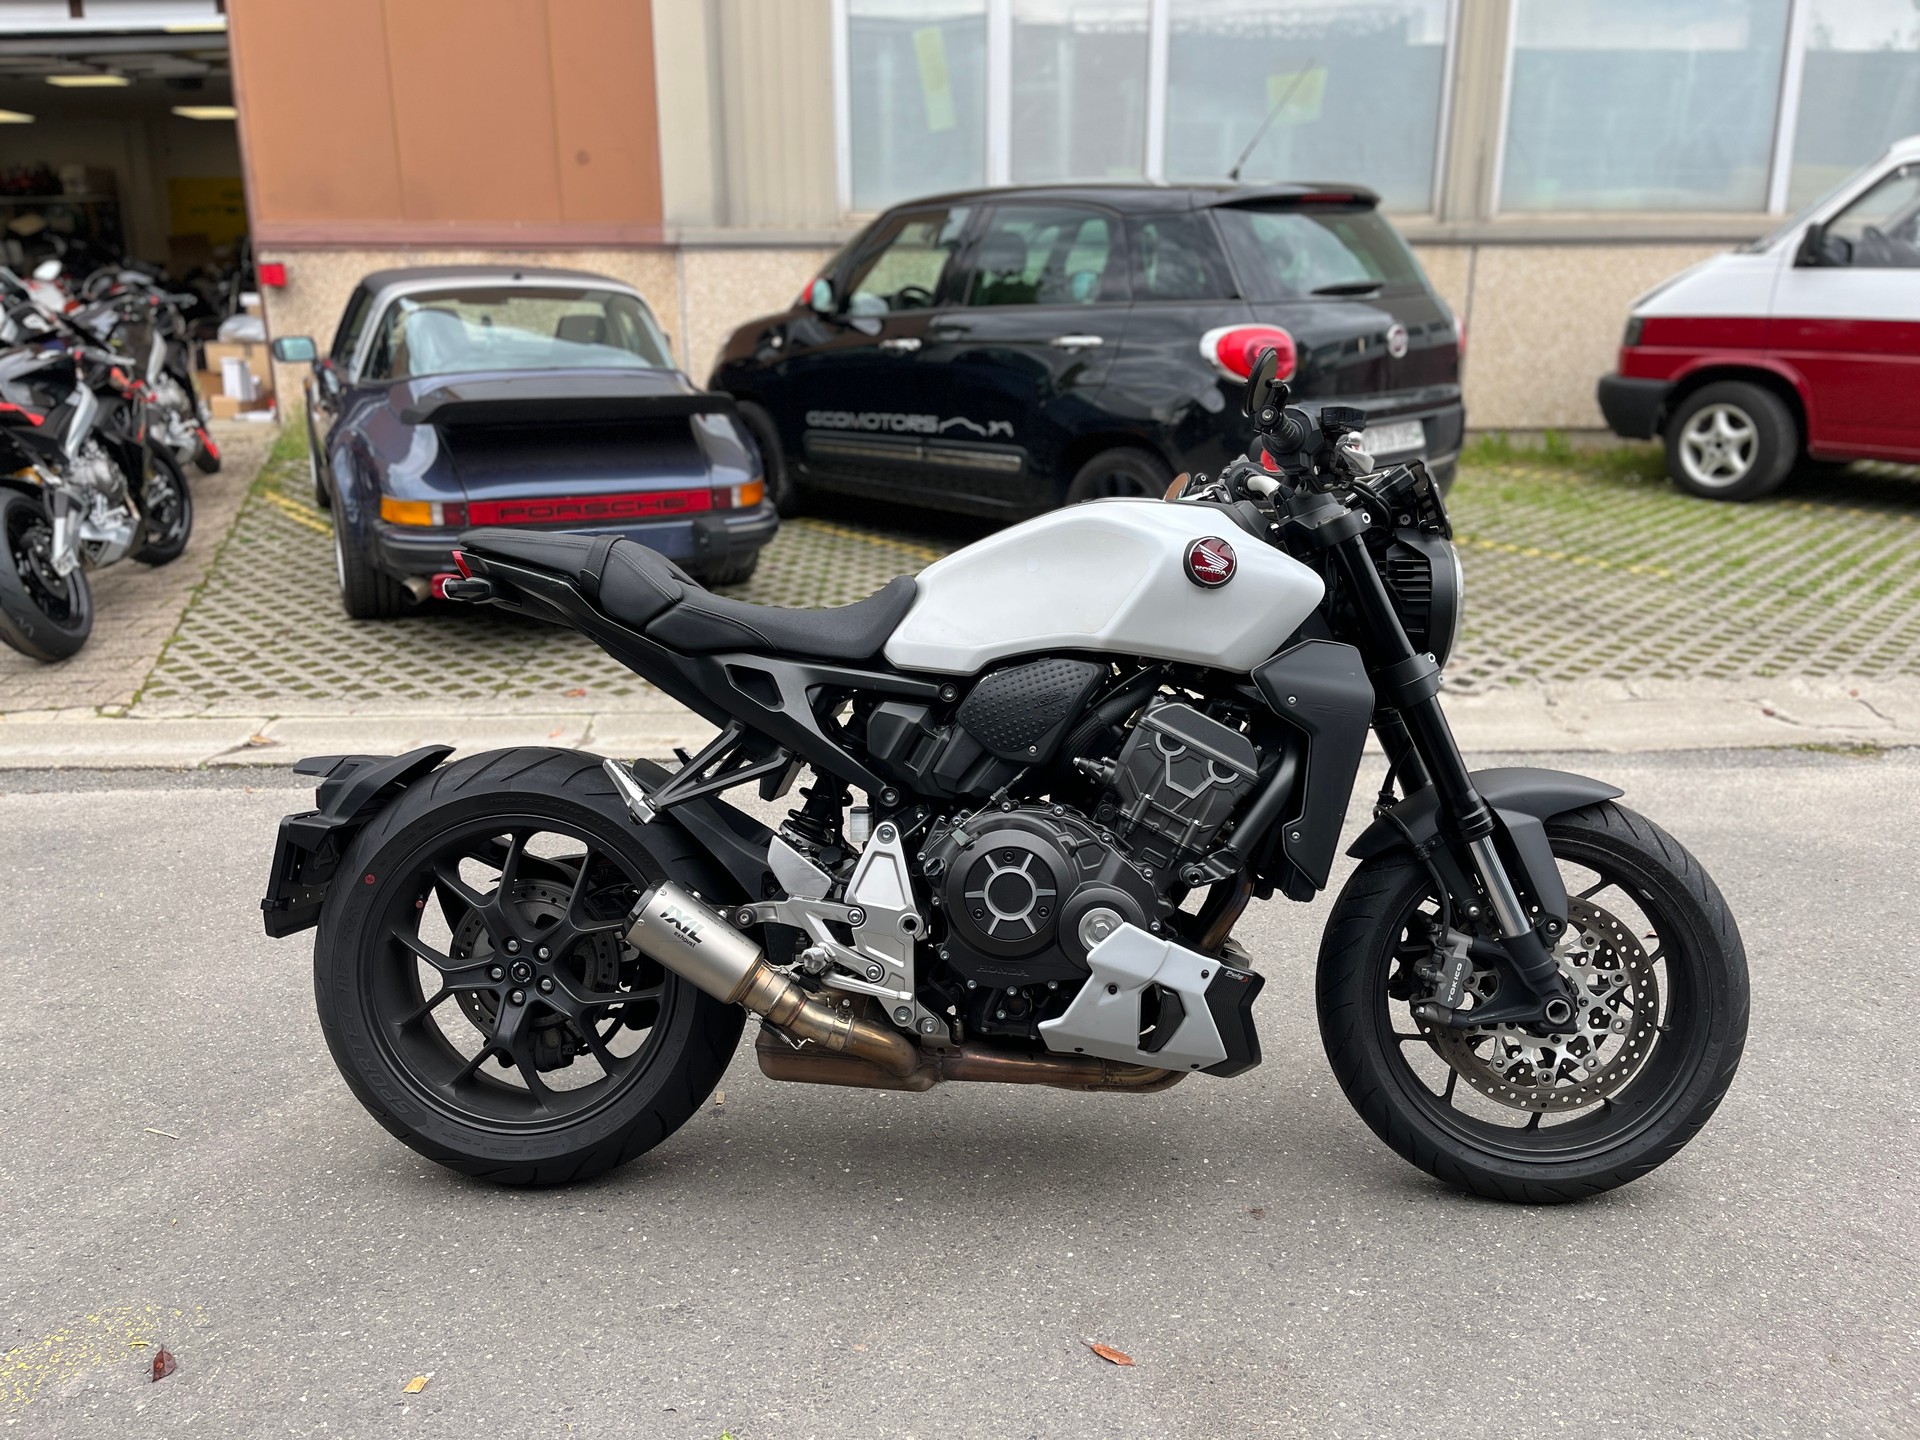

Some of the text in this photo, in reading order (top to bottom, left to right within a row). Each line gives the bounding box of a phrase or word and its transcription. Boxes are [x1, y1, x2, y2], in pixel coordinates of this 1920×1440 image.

[500, 498, 686, 519] PORSCHE
[1194, 565, 1227, 576] HONDA
[660, 905, 705, 943] IXIL
[674, 931, 697, 948] exhaust
[976, 965, 1029, 977] HONDA
[1447, 962, 1463, 1002] TOKICO
